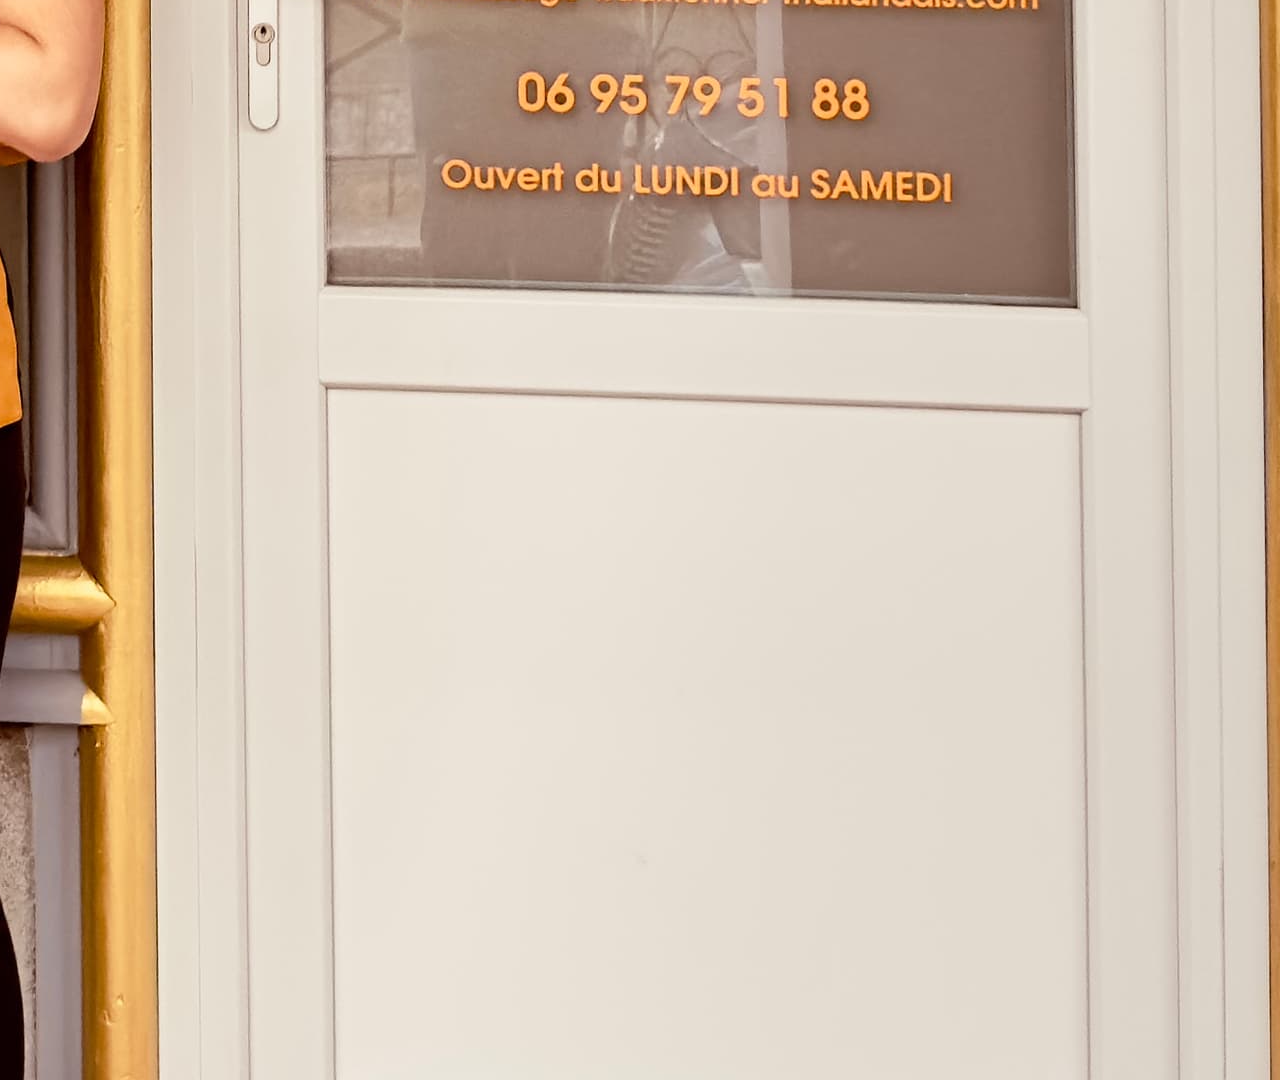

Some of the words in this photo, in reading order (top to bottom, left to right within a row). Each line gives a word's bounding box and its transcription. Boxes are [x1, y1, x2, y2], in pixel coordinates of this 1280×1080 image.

[518, 71, 576, 114] 06
[590, 73, 648, 116] 95
[665, 75, 722, 117] 79
[738, 77, 789, 119] 51
[811, 78, 870, 120] 88
[441, 159, 565, 193] Ouvert
[575, 163, 623, 194] du
[634, 164, 740, 197] LUNDI
[751, 173, 800, 199] au
[810, 169, 953, 204] SAMEDI
